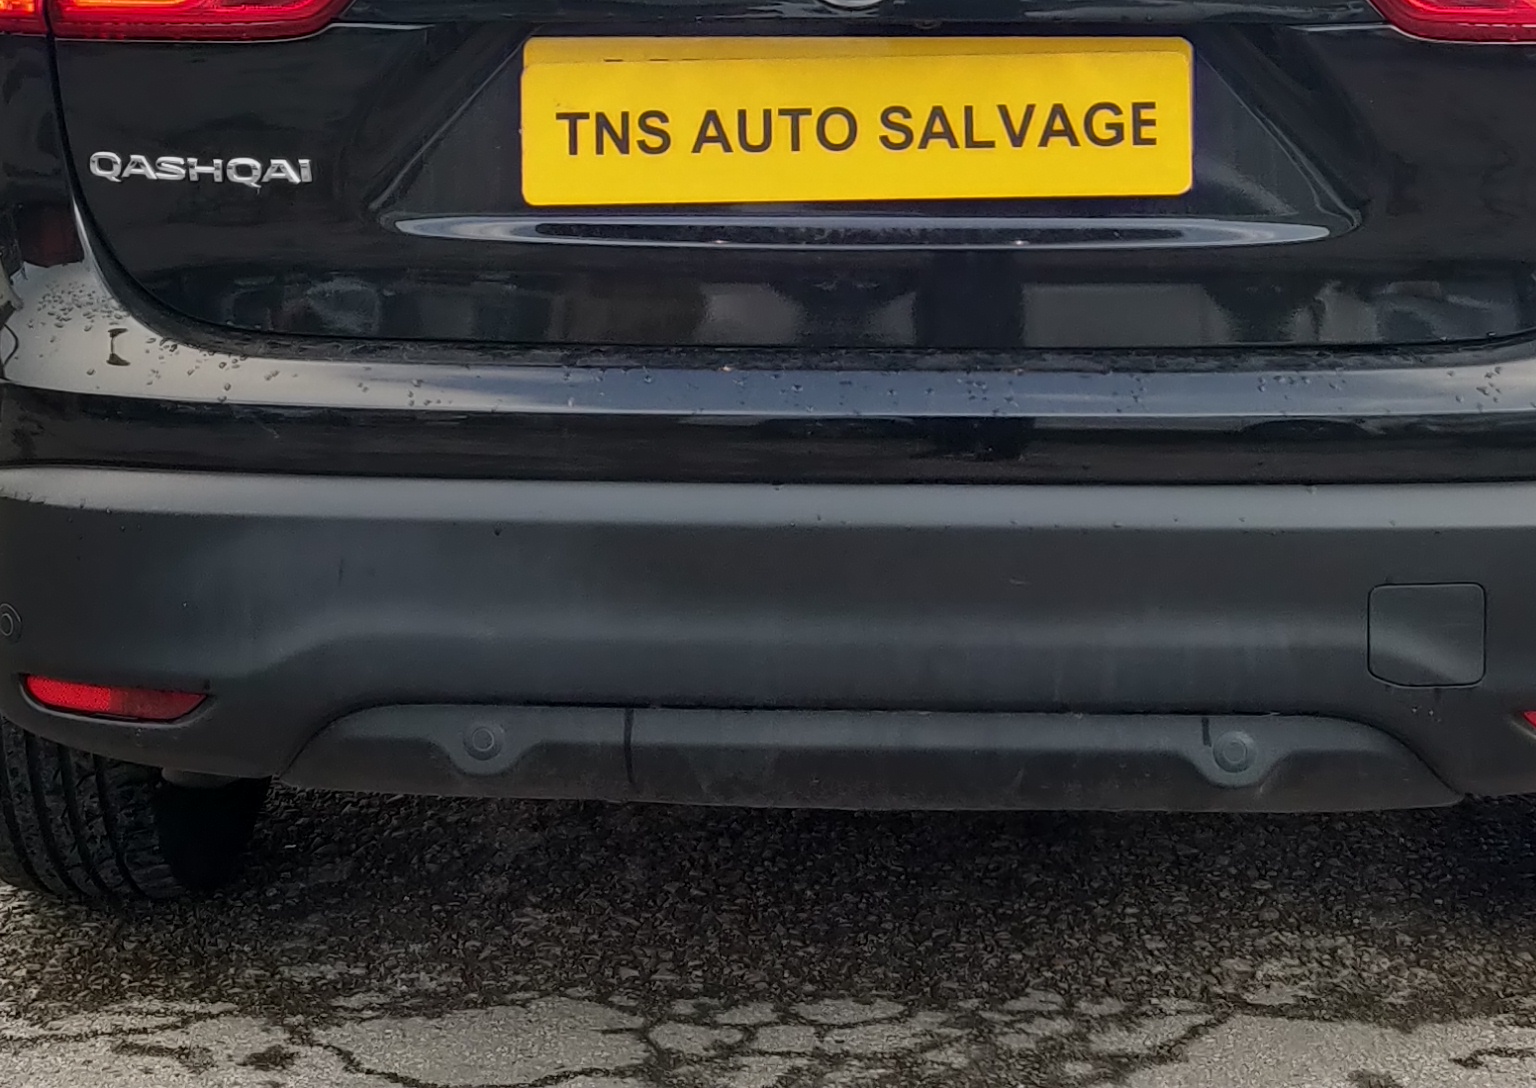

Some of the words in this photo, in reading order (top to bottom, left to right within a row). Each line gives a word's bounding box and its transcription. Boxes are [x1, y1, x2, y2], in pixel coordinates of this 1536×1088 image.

[556, 110, 671, 156] TNS
[692, 107, 858, 154] AUTO
[879, 101, 1157, 151] SALVAGE
[89, 151, 313, 189] QASHQAI
